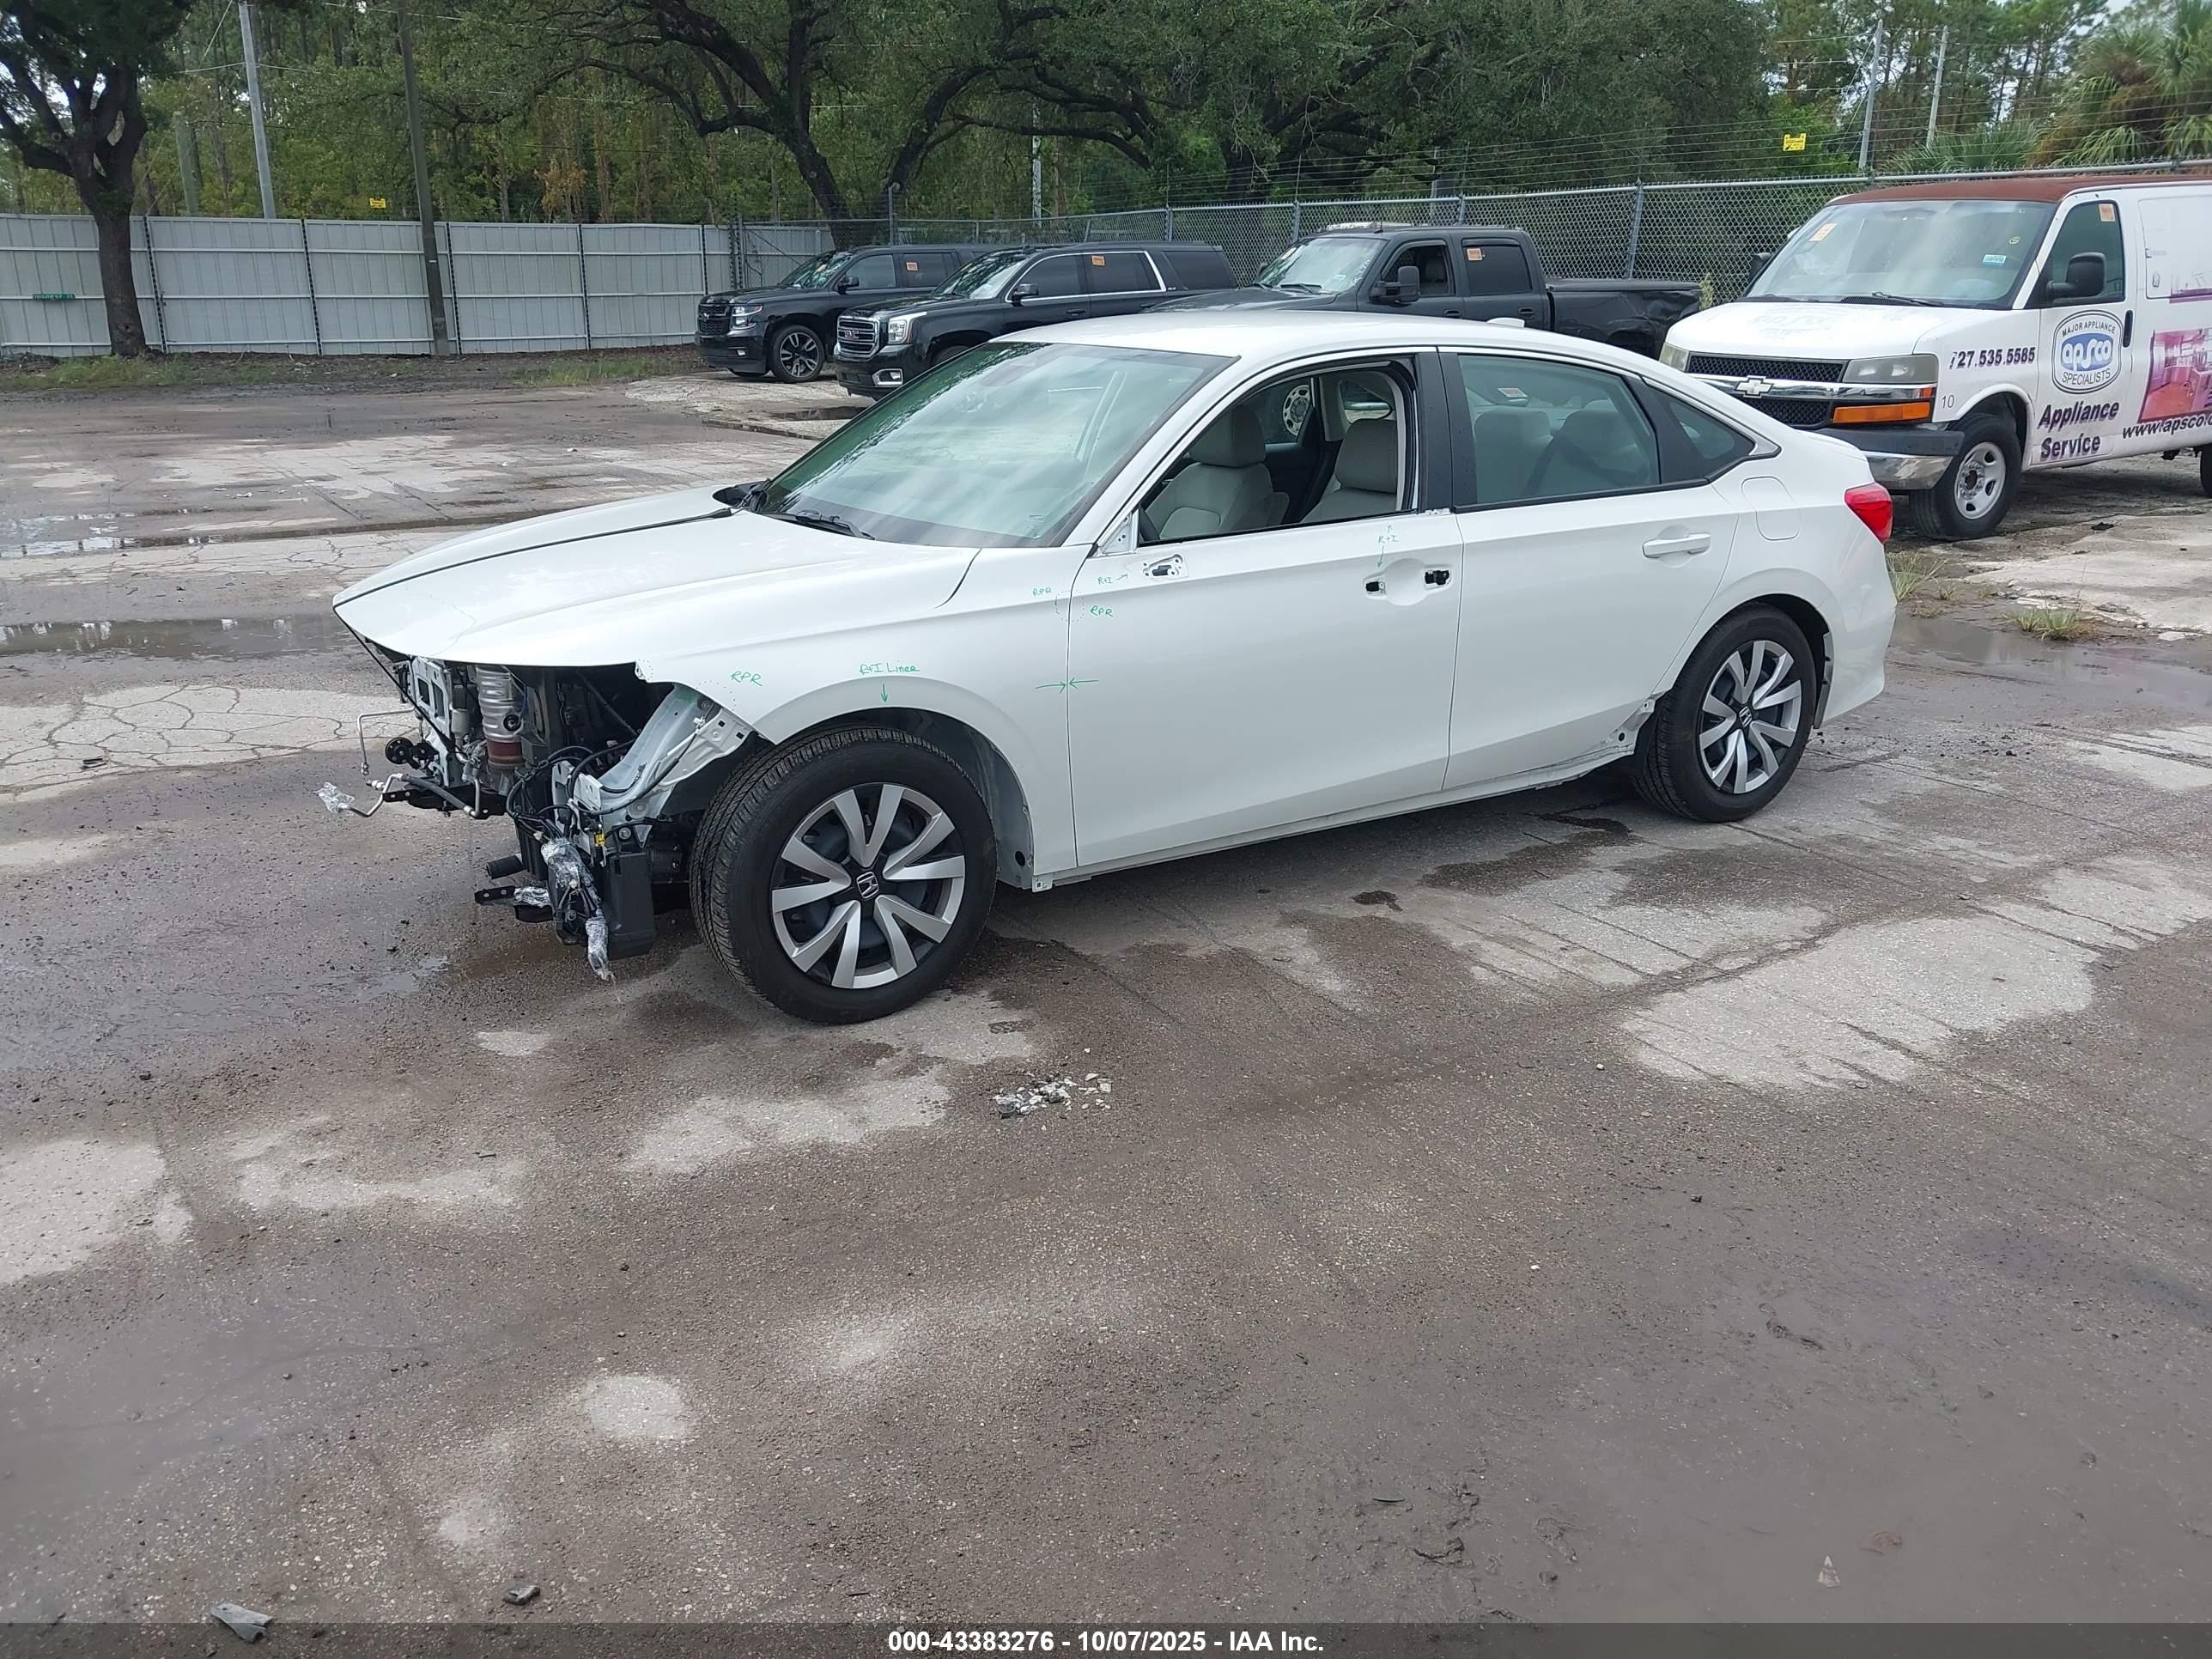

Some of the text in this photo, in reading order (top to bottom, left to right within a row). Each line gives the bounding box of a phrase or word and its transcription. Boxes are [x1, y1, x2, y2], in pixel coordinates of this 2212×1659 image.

[2062, 320, 2116, 337] MAJOR APPLIANCE
[2062, 368, 2111, 386] SPECIALISTS
[1942, 394, 1955, 409] 10
[2038, 400, 2120, 433] Appliance
[2039, 433, 2101, 461] Service
